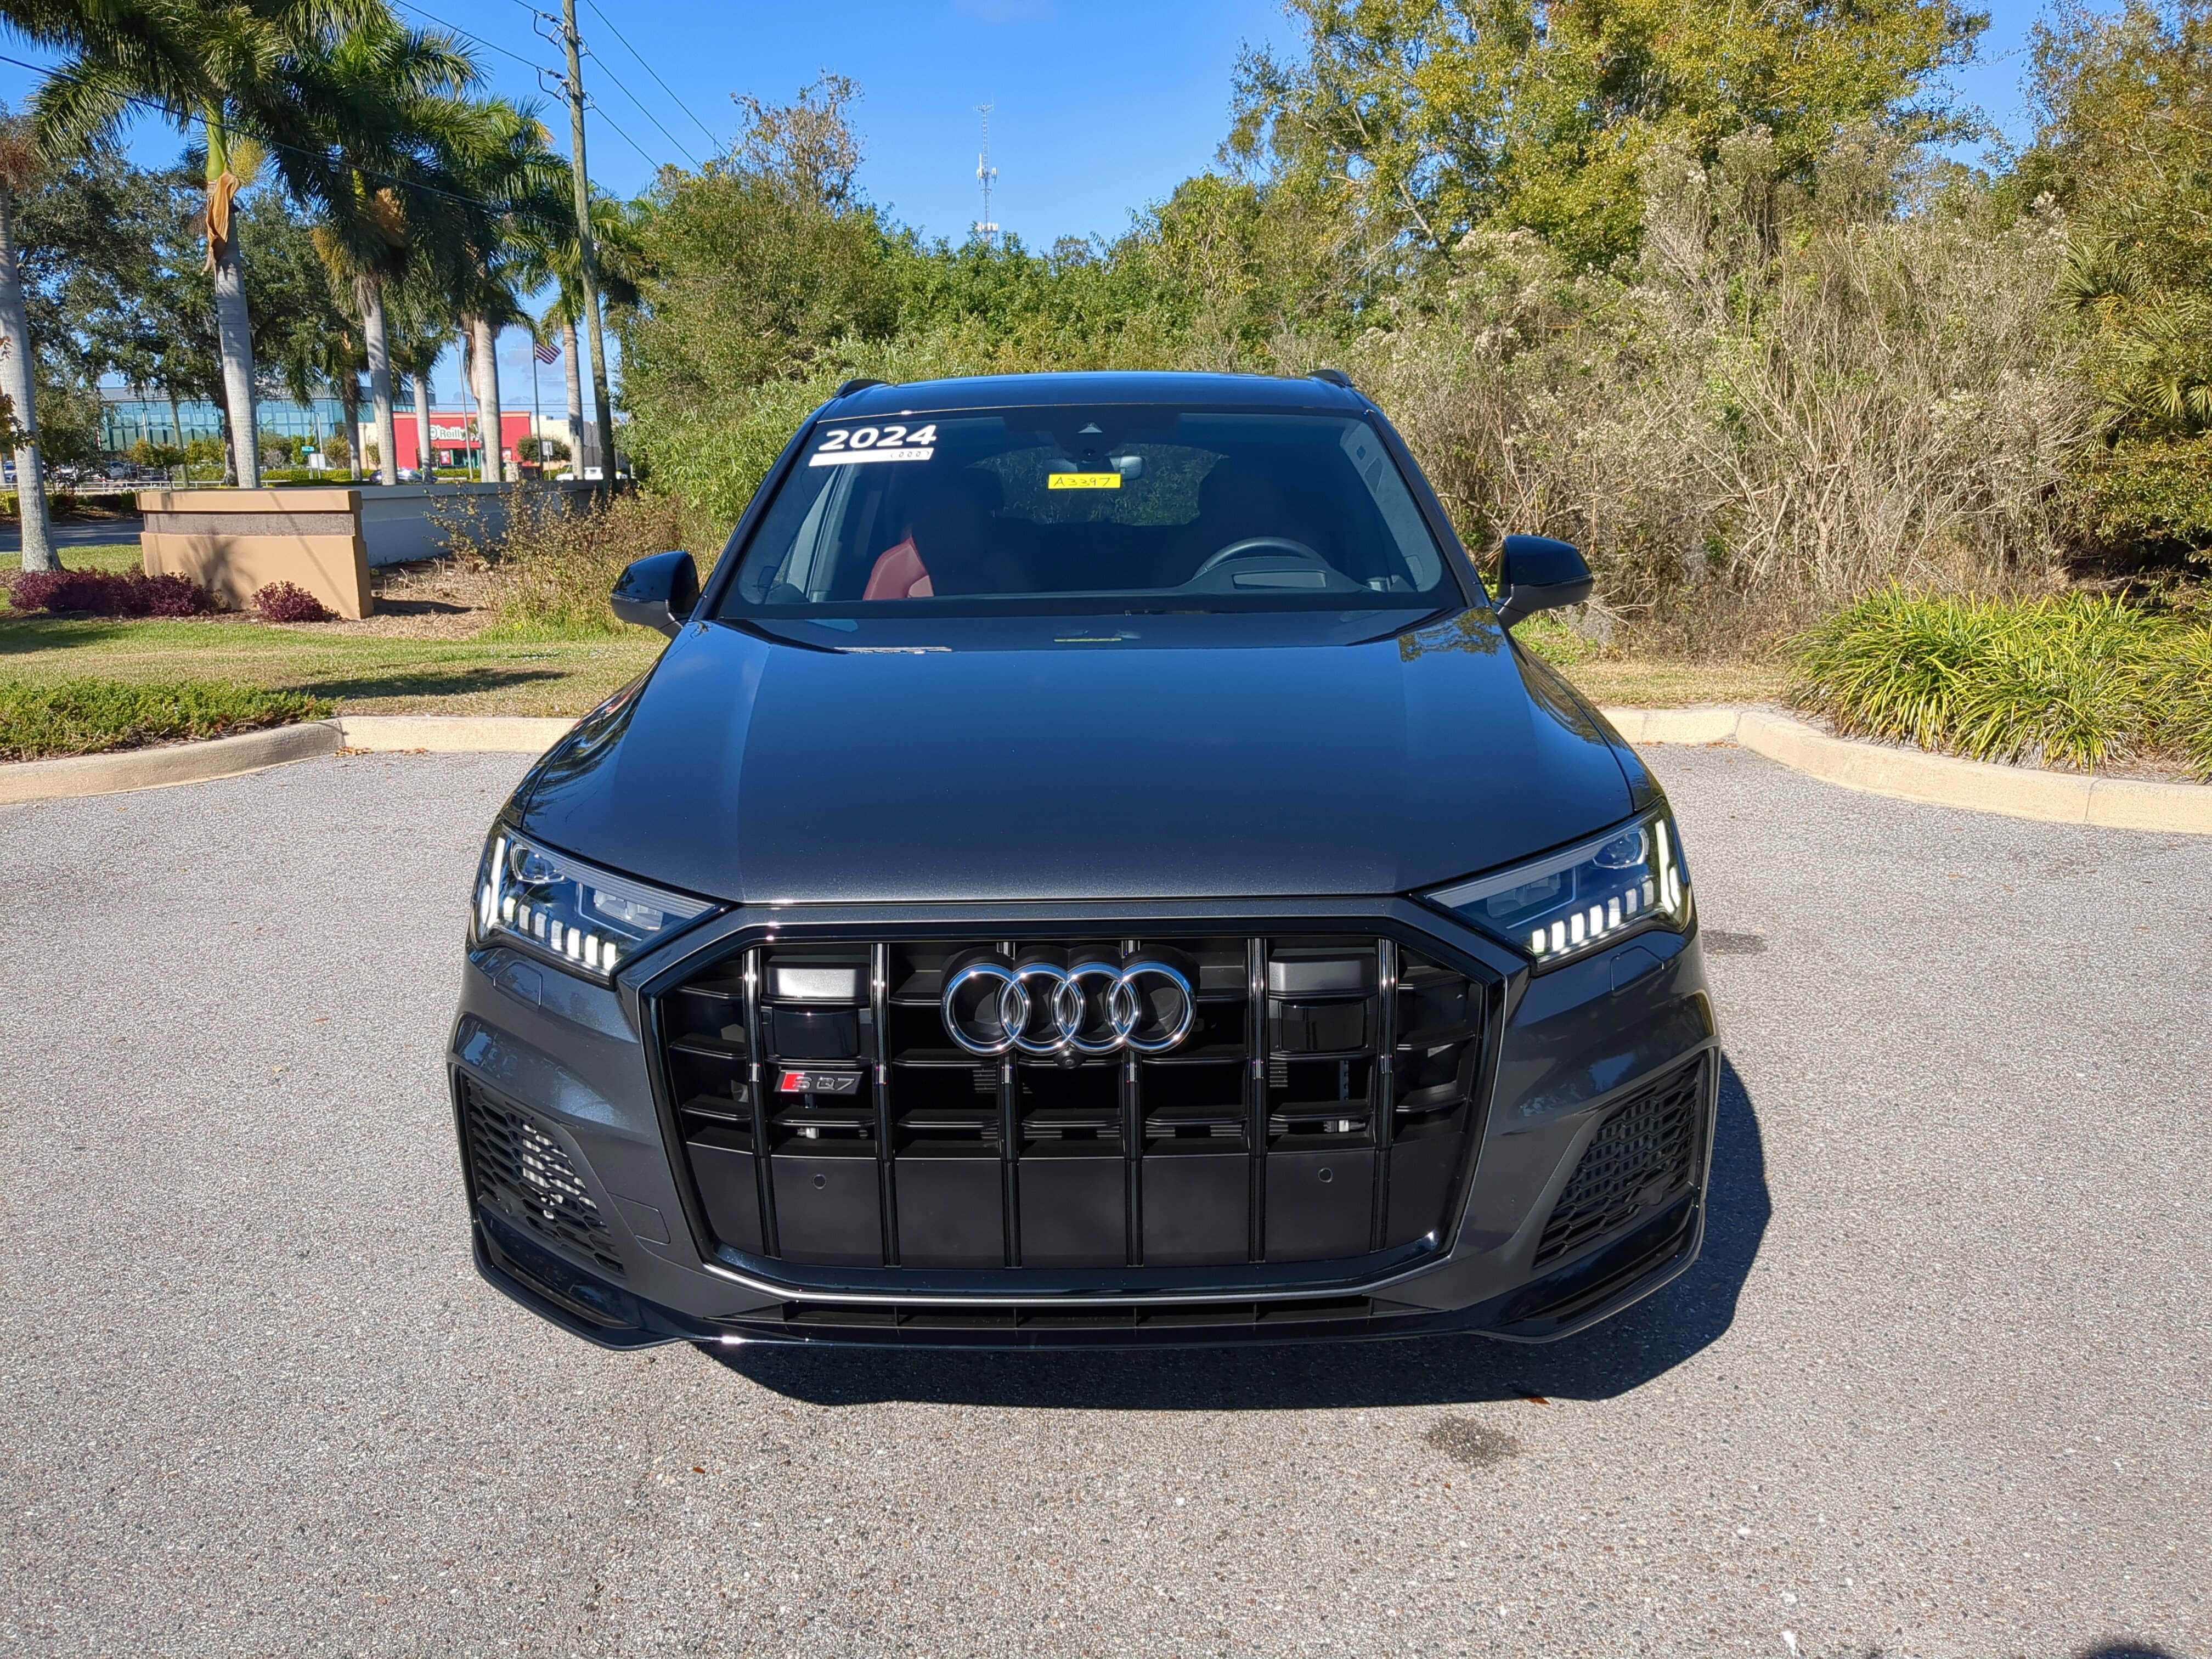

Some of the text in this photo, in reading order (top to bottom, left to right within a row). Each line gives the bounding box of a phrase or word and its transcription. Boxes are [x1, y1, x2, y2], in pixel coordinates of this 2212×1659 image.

[818, 425, 937, 450] 2024
[1053, 476, 1111, 487] A3397
[793, 1075, 855, 1091] SQ7
